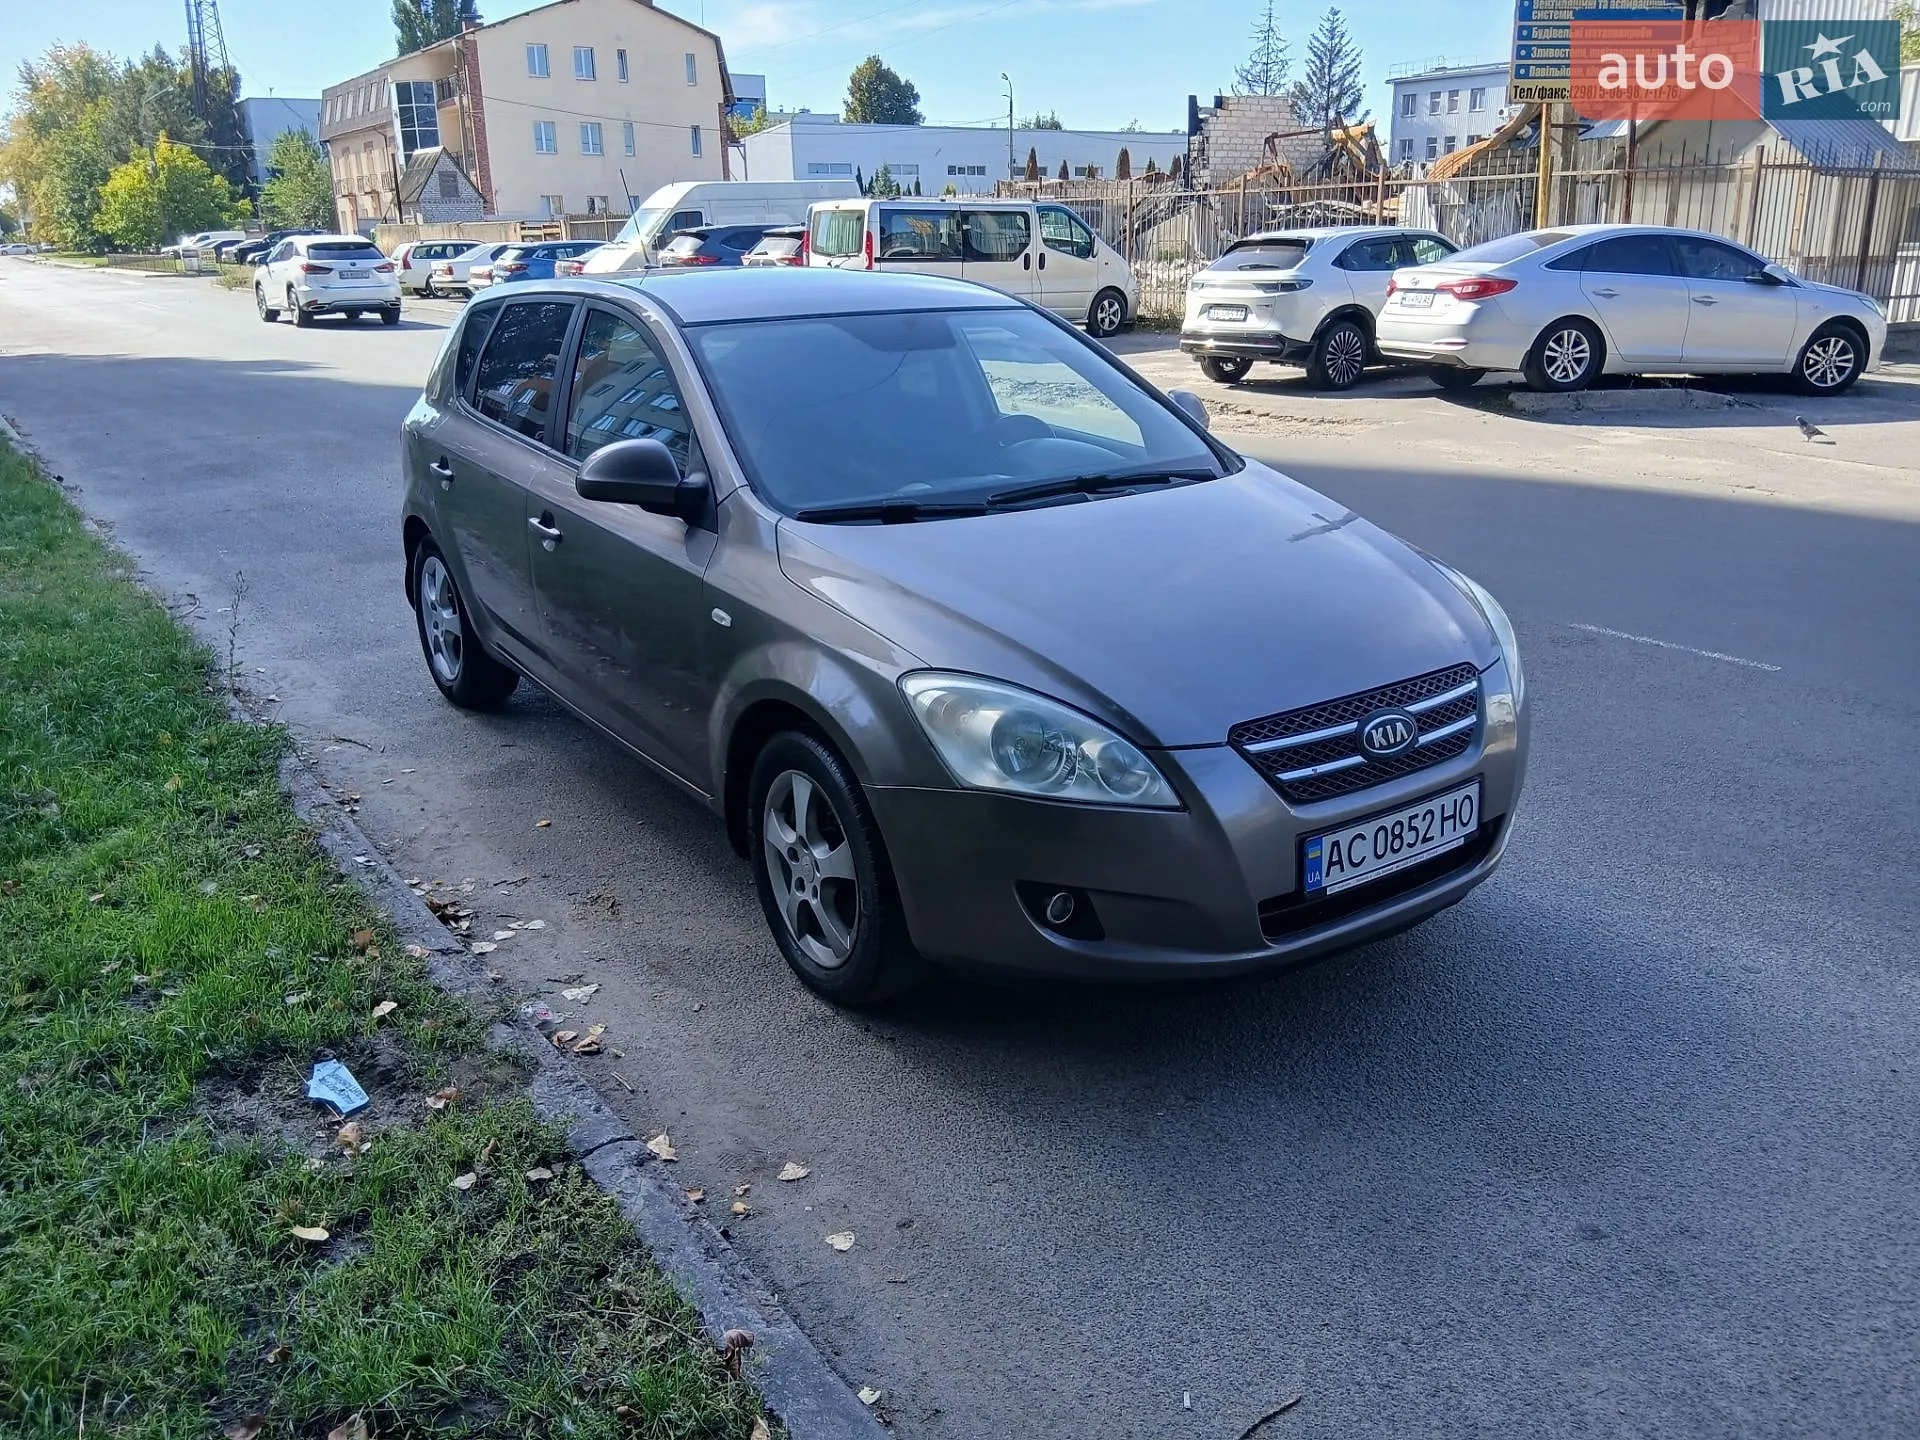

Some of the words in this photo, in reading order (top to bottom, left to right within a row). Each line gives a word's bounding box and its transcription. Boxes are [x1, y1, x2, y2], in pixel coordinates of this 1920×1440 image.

[1370, 721, 1409, 749] KIA
[1325, 832, 1368, 878] AC
[1373, 808, 1435, 860] 0852
[1440, 793, 1474, 838] HO
[1307, 870, 1321, 883] UA
